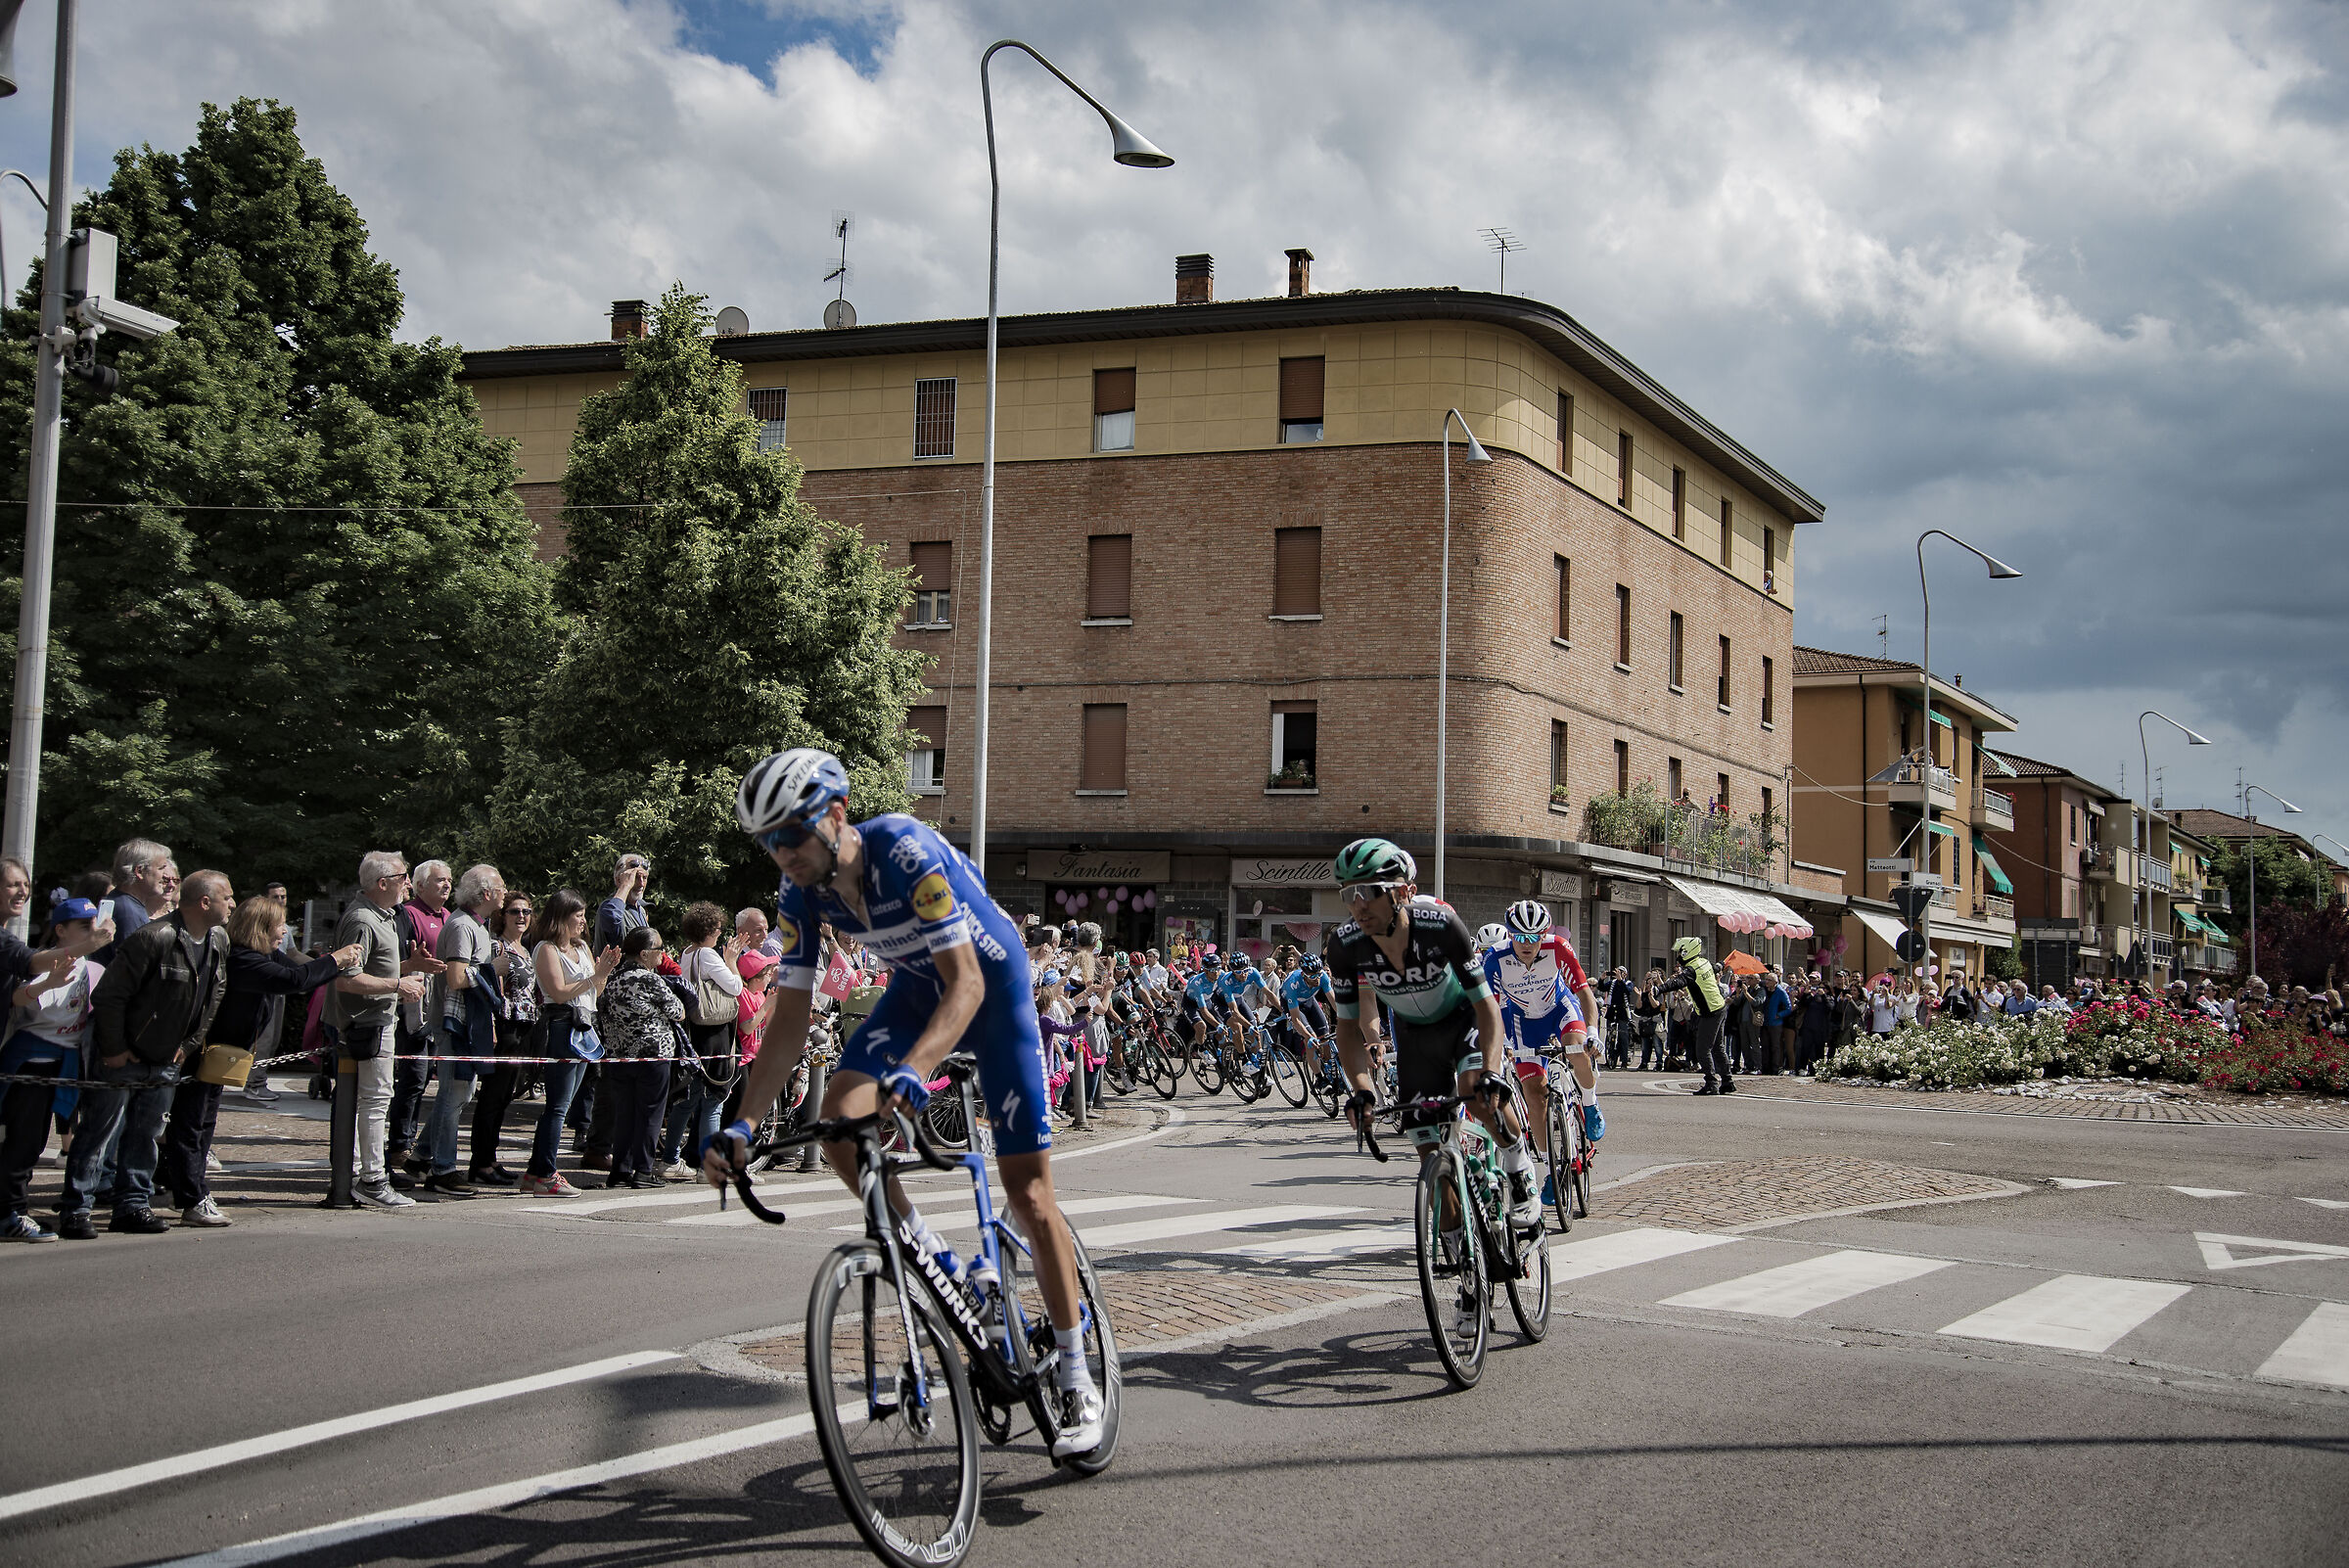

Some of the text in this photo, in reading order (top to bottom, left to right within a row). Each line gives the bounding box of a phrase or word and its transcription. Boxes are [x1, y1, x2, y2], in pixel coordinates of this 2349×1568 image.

[889, 844, 919, 874] PRO
[1053, 853, 1142, 878] Fantasia
[1246, 859, 1331, 884] Scintille
[1547, 872, 1578, 897] Scintille
[869, 899, 902, 916] latexco
[1413, 908, 1447, 921] BORA
[1336, 920, 1361, 937] BOR
[1363, 961, 1443, 987] BORA
[1507, 977, 1553, 989] Groupama
[898, 1220, 990, 1351] S-WORKS
